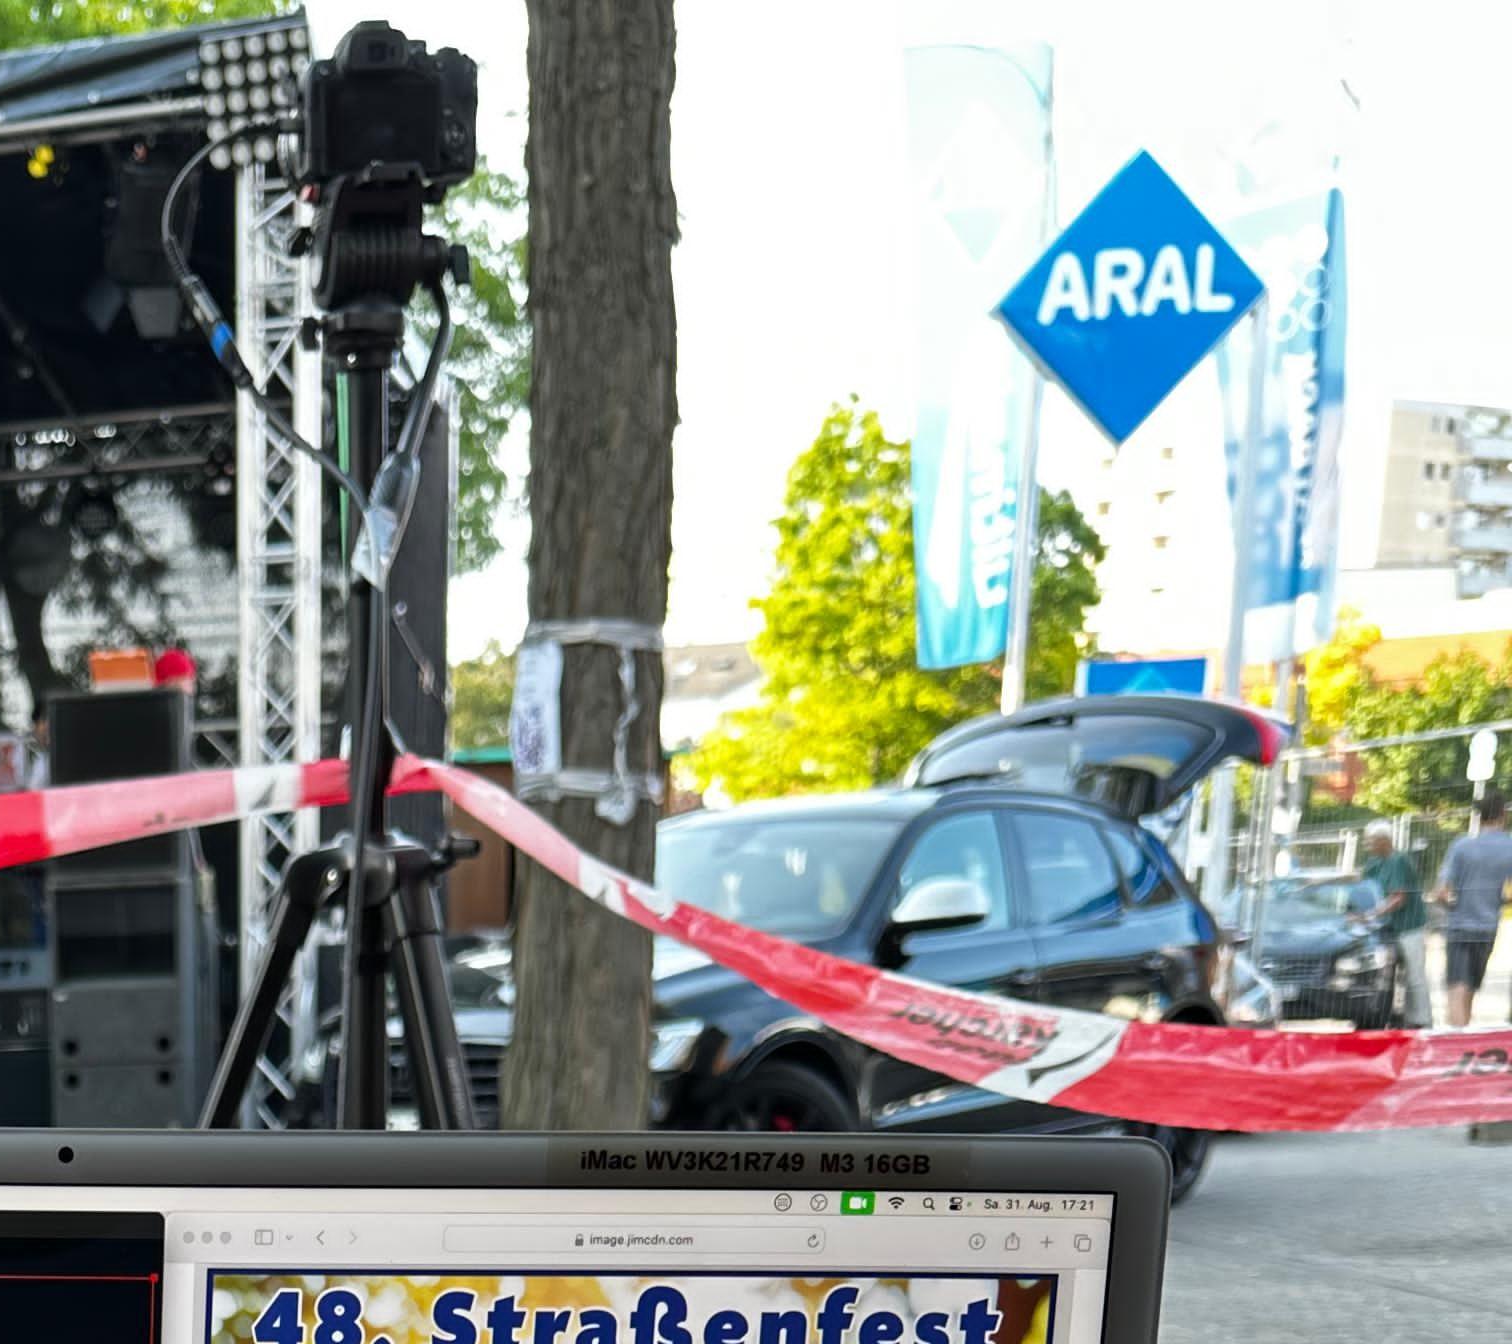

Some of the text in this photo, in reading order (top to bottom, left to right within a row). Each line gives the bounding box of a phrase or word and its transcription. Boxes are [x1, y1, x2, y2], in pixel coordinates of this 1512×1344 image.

[1036, 243, 1236, 326] ARAL
[580, 1152, 931, 1175] iMac WV3K21R749 M3 16GB
[1062, 1199, 1095, 1211] 17:21
